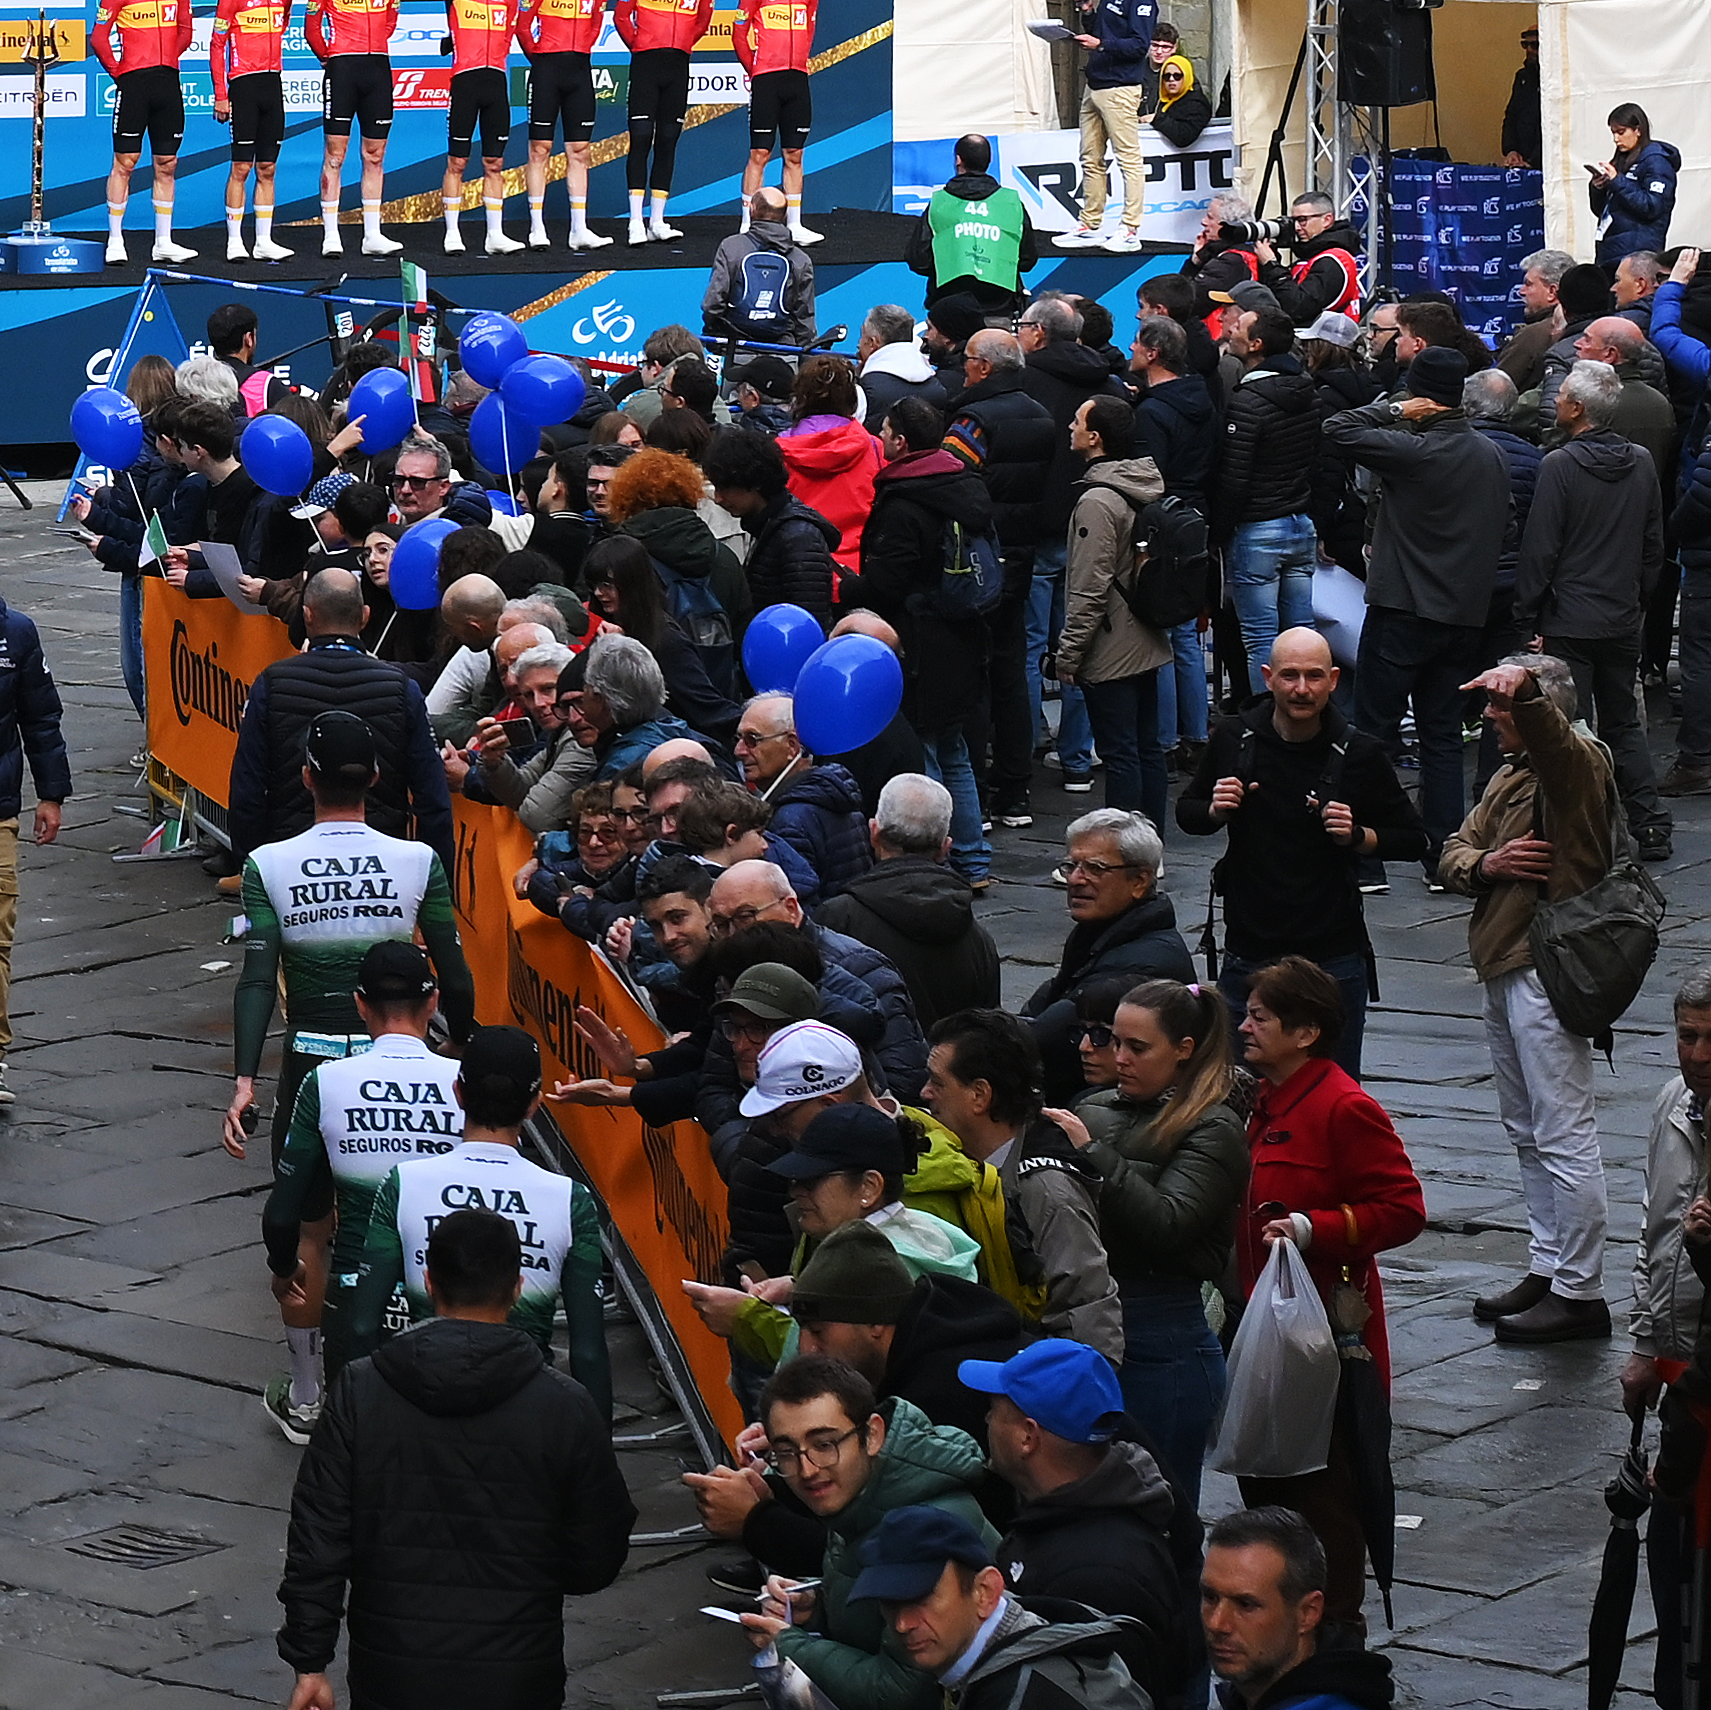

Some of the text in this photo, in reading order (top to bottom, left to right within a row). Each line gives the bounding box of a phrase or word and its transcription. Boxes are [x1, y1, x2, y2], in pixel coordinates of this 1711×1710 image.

[464, 9, 486, 21] Uno
[550, 0, 574, 9] Uno
[132, 11, 157, 21] Uno
[767, 11, 791, 21] Uno
[687, 76, 738, 92] UDOR
[964, 201, 989, 217] 44
[954, 221, 1001, 242] PHOTO
[169, 618, 252, 734] Contine
[300, 854, 387, 878] CAJA
[288, 878, 399, 908] RURAL
[282, 904, 404, 928] SEGUROS RGA
[359, 1080, 447, 1105] CAJA
[784, 1075, 847, 1097] COLNAGO
[343, 1107, 464, 1138] RURAL
[338, 1138, 454, 1155] SEGUROS RG
[440, 1184, 531, 1215] CAJA
